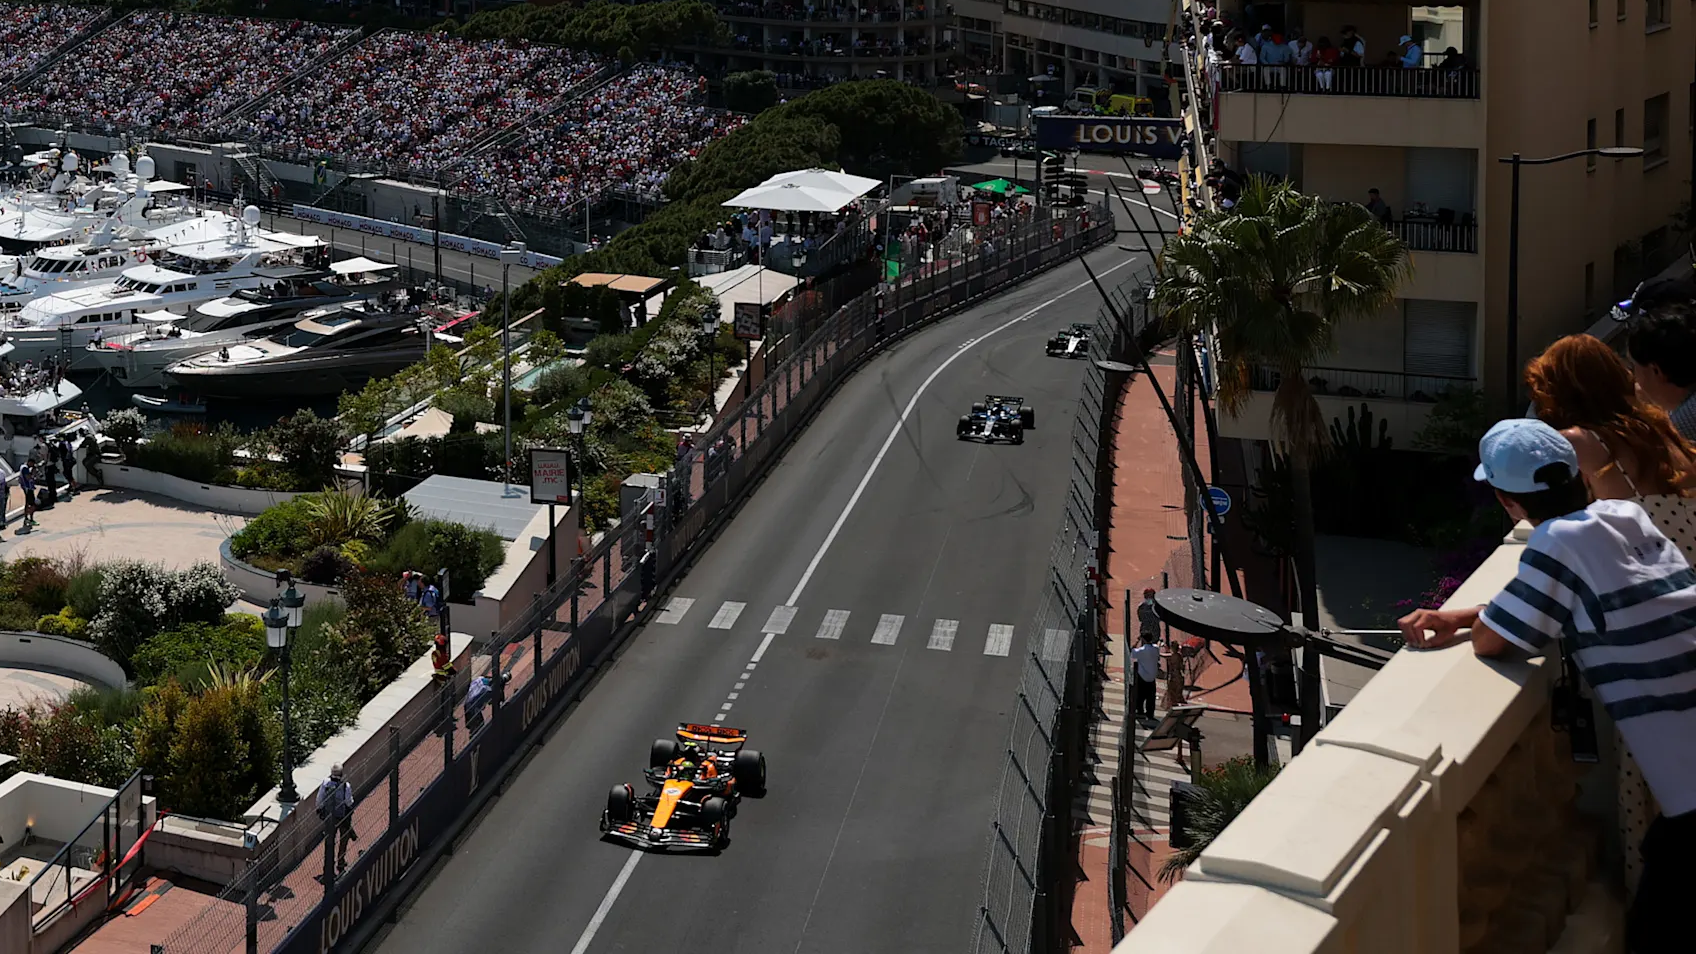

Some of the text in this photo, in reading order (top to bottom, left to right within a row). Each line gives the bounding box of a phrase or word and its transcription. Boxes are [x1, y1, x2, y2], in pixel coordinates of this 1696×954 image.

[1079, 124, 1158, 145] LOUIS
[297, 211, 321, 221] MONACO
[328, 217, 352, 228] MONACO
[359, 223, 383, 234] MONACO
[390, 229, 414, 240] MONACO
[440, 239, 465, 250] MONACO
[472, 245, 496, 257] MONACO
[534, 469, 565, 477] MAIRIE
[522, 639, 581, 732] LOUIS VUITTON
[321, 815, 420, 954] LOUIS VUITTON
